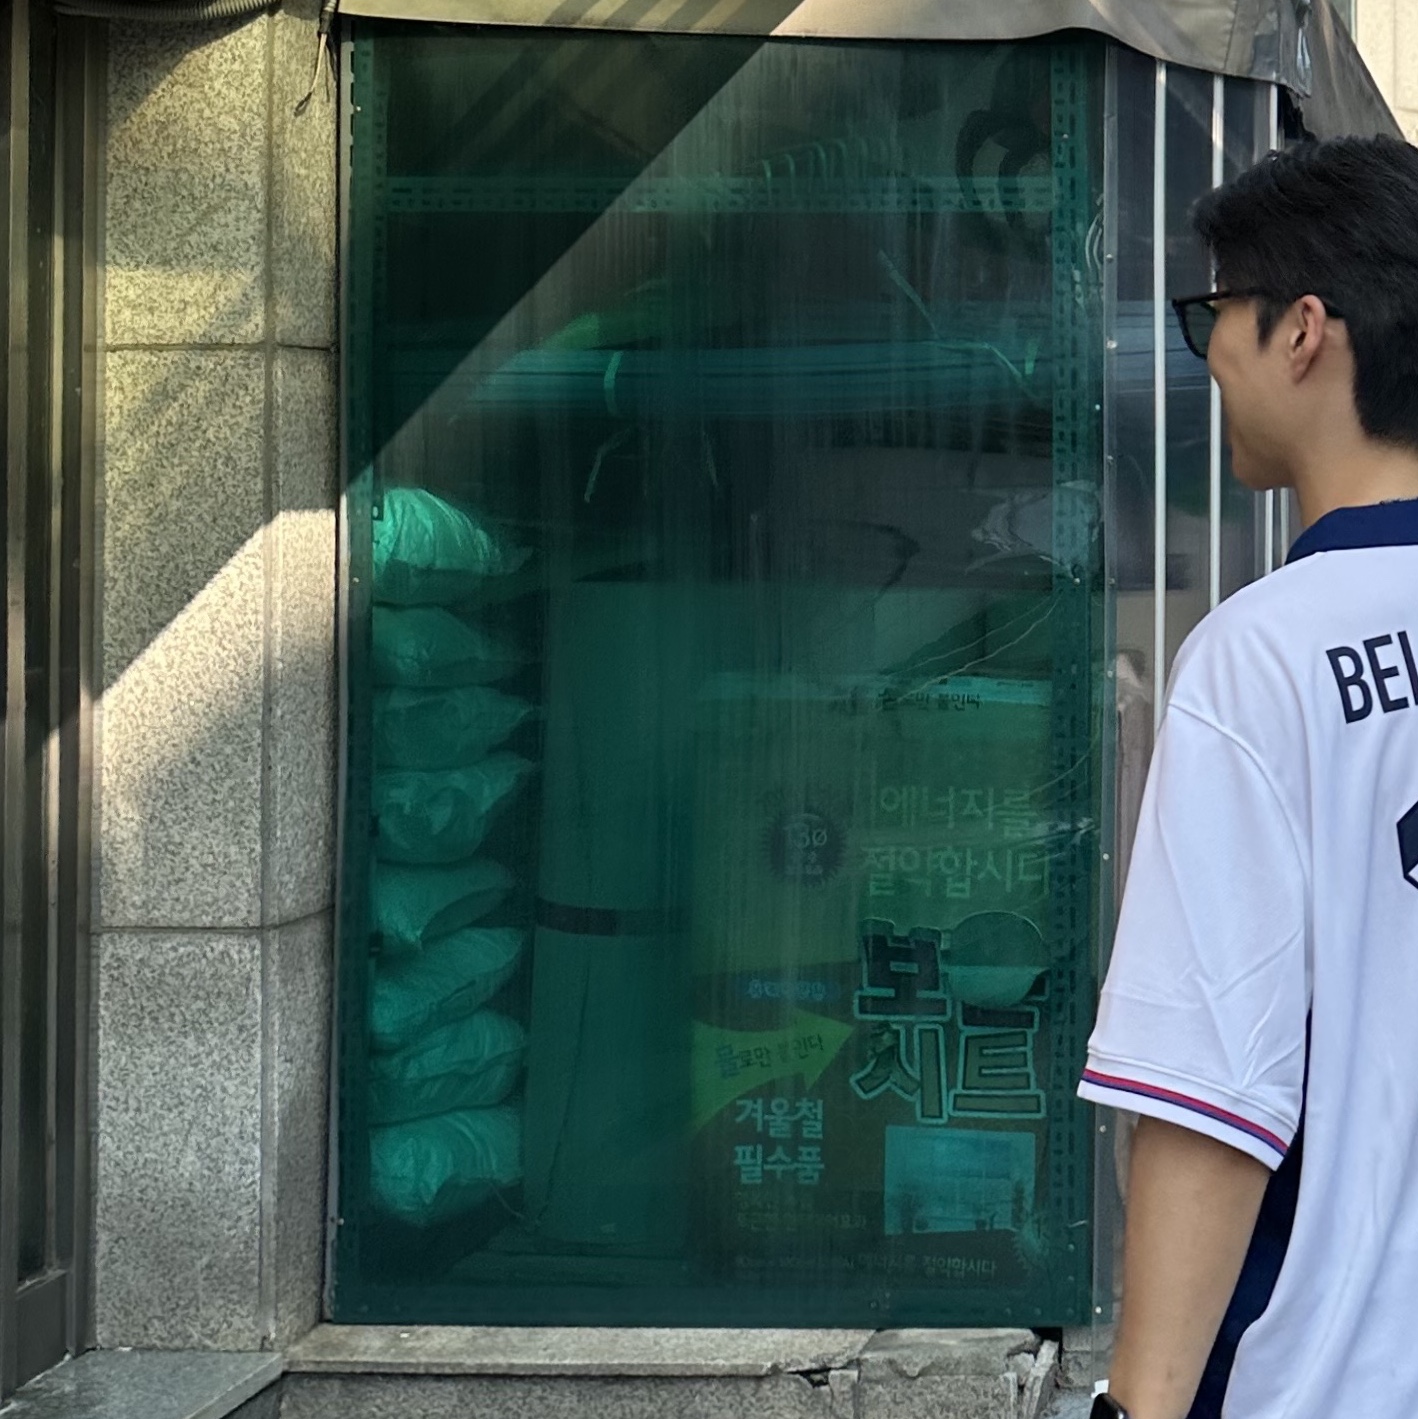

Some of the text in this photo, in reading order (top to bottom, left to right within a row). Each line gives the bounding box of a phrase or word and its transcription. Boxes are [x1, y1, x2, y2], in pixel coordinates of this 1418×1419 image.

[880, 785, 1038, 840] 에너지를
[735, 1098, 824, 1140] 겨울철
[734, 1144, 825, 1186] 필수품
